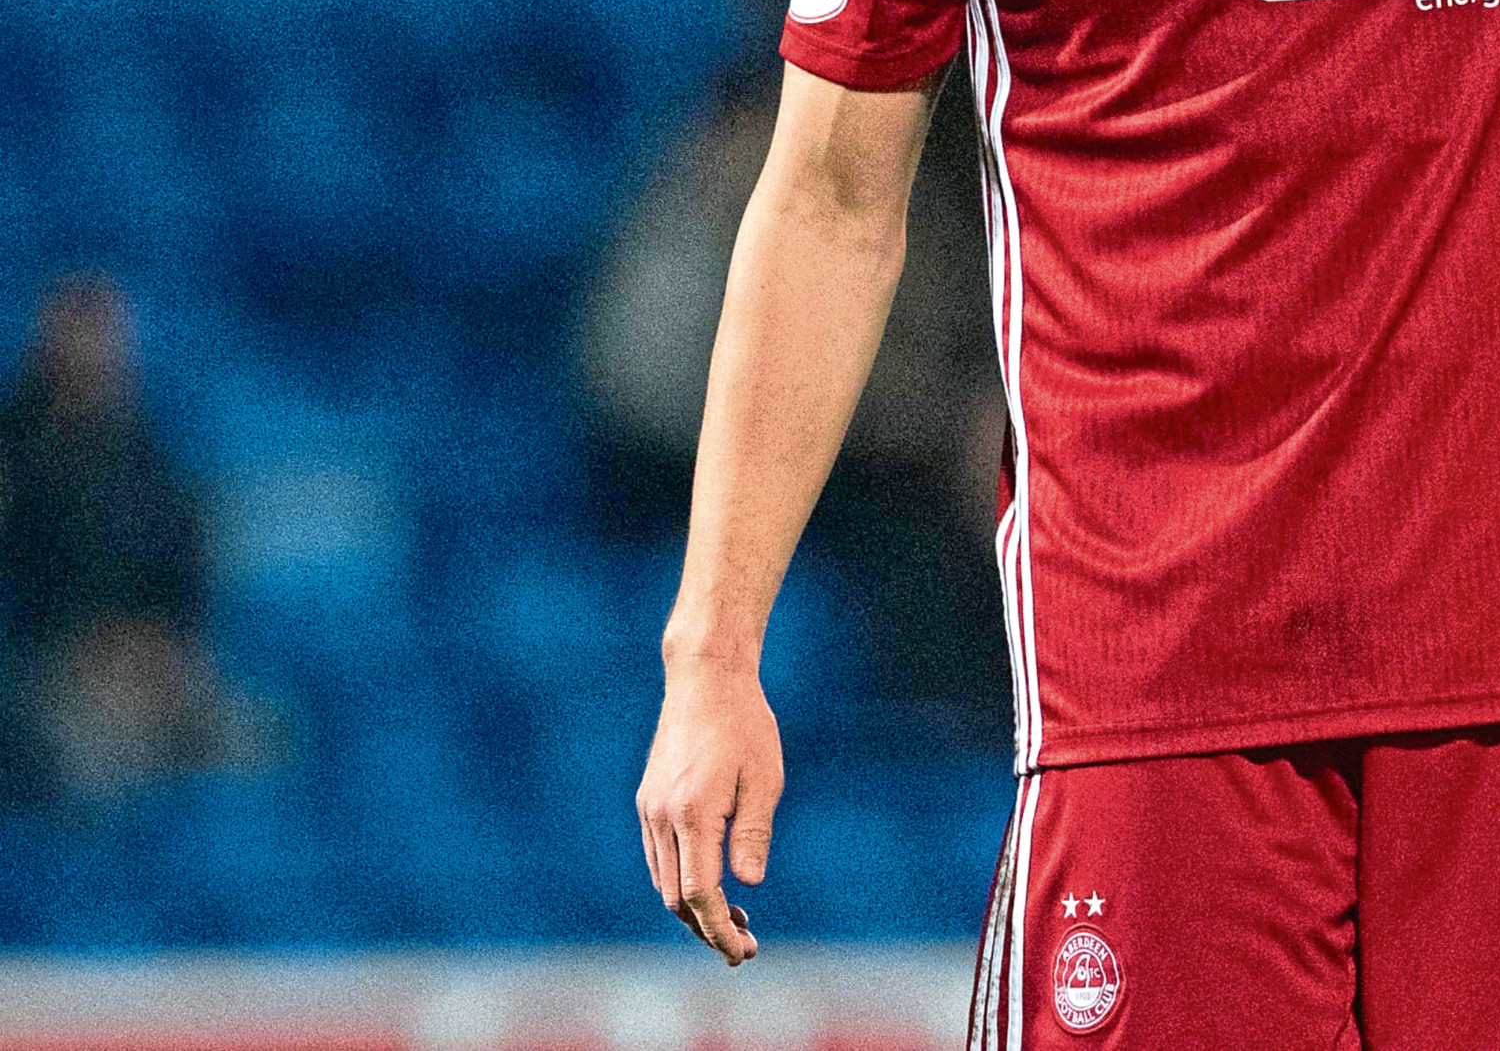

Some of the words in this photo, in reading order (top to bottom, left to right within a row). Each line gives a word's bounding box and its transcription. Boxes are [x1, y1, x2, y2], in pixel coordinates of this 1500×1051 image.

[1062, 937, 1109, 962] ABERDEEN
[1056, 986, 1096, 1025] FOOTBALL
[1094, 983, 1116, 1016] CLUB
